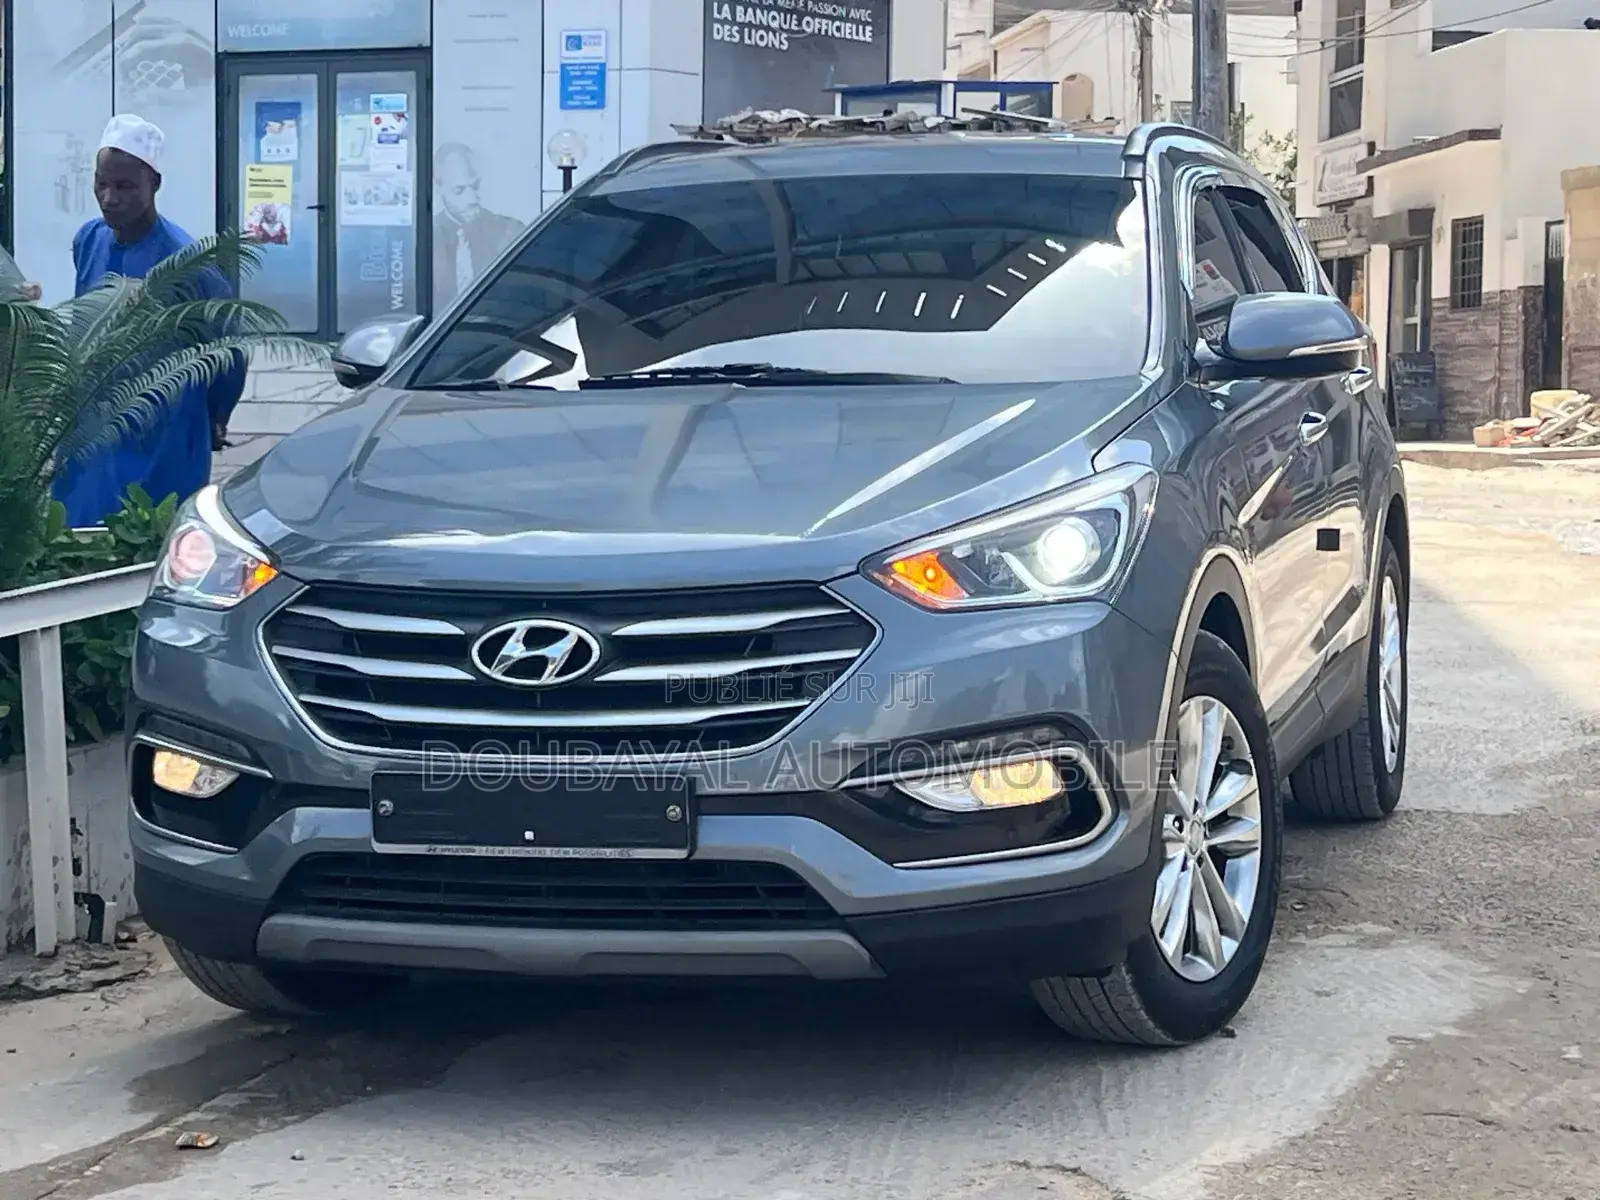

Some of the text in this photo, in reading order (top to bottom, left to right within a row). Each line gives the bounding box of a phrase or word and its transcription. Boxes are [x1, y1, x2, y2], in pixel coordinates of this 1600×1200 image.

[713, 1, 873, 43] LA BANQUE OFFICIELLE
[807, 0, 847, 17] PASSION
[848, 7, 873, 22] AVEC
[228, 22, 290, 38] WELCOME
[713, 23, 789, 50] DES LIONS
[390, 240, 404, 310] WELCOME
